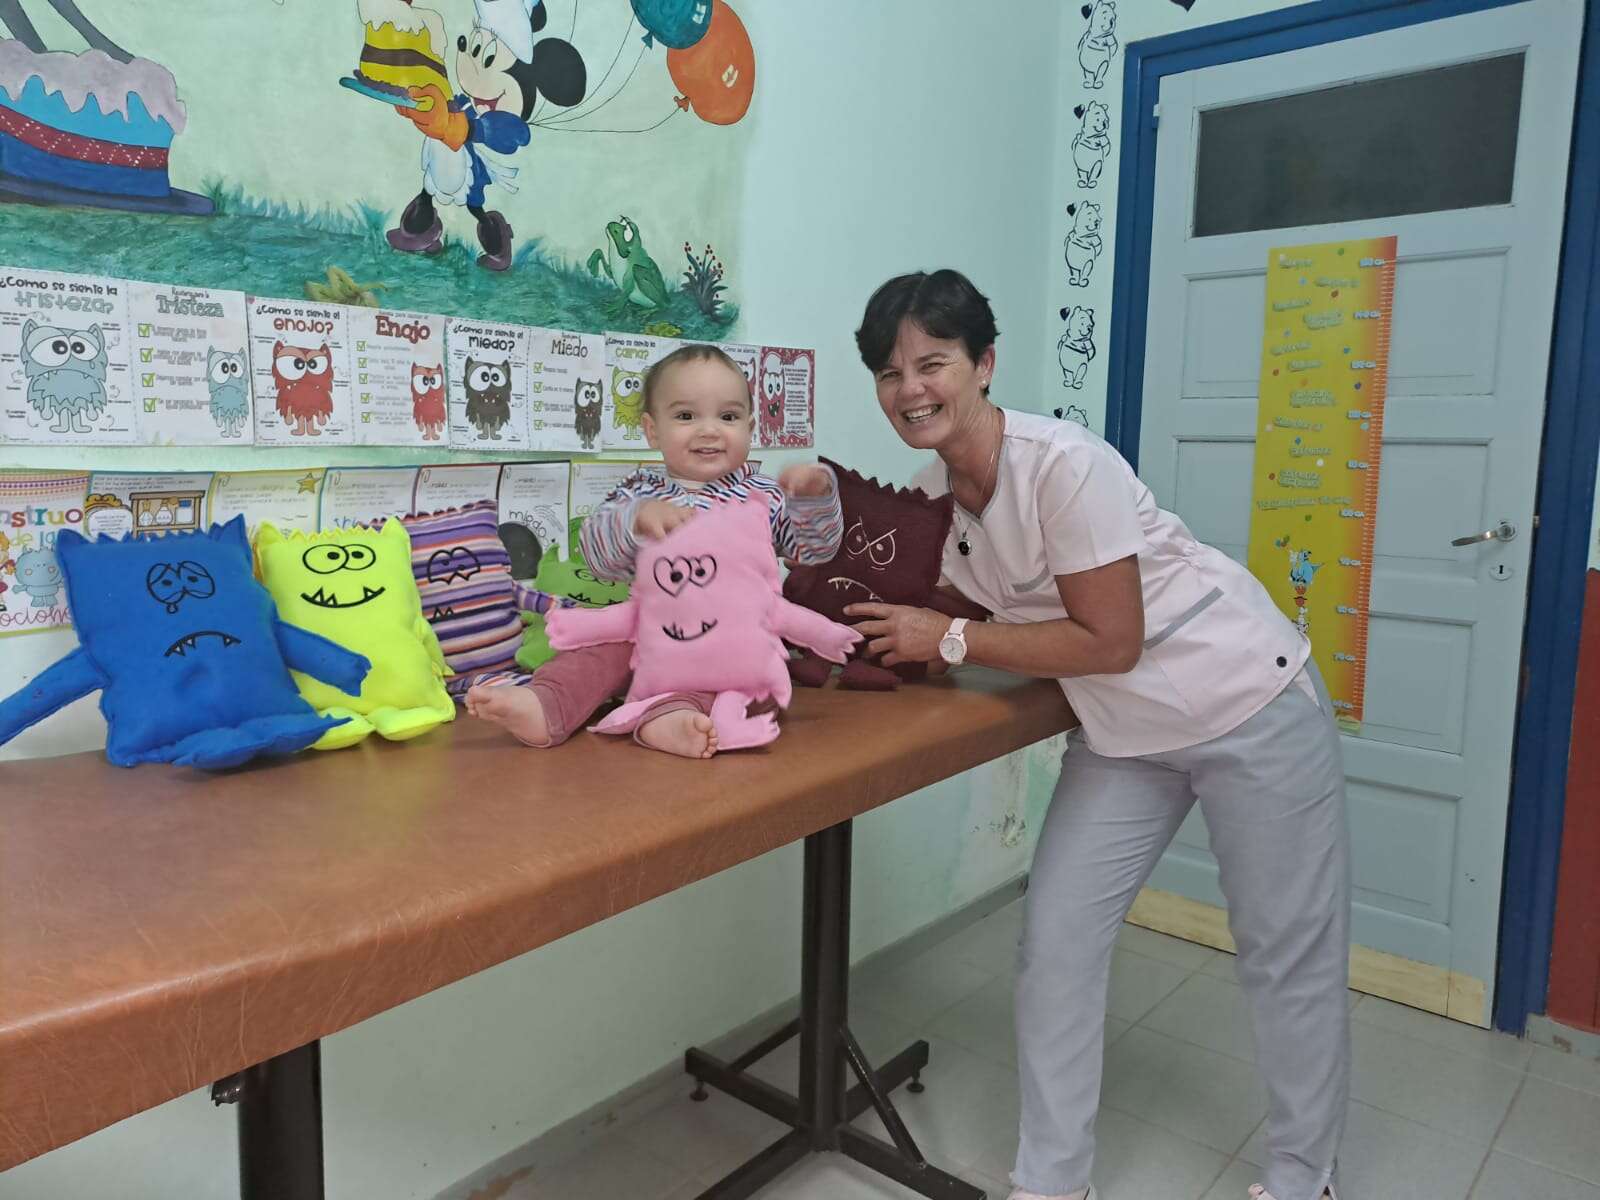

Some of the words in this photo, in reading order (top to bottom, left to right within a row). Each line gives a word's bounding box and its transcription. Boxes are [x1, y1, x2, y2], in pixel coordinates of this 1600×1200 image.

[52, 281, 65, 291] se
[69, 283, 103, 295] siente
[106, 285, 118, 296] la
[14, 291, 114, 315] tristeza?
[156, 294, 224, 318] Tristeza
[256, 304, 291, 315] ¿Como
[273, 317, 334, 335] enojo?
[375, 315, 431, 344] Enojo
[453, 324, 483, 334] ¿Como
[551, 336, 588, 358] Miedo
